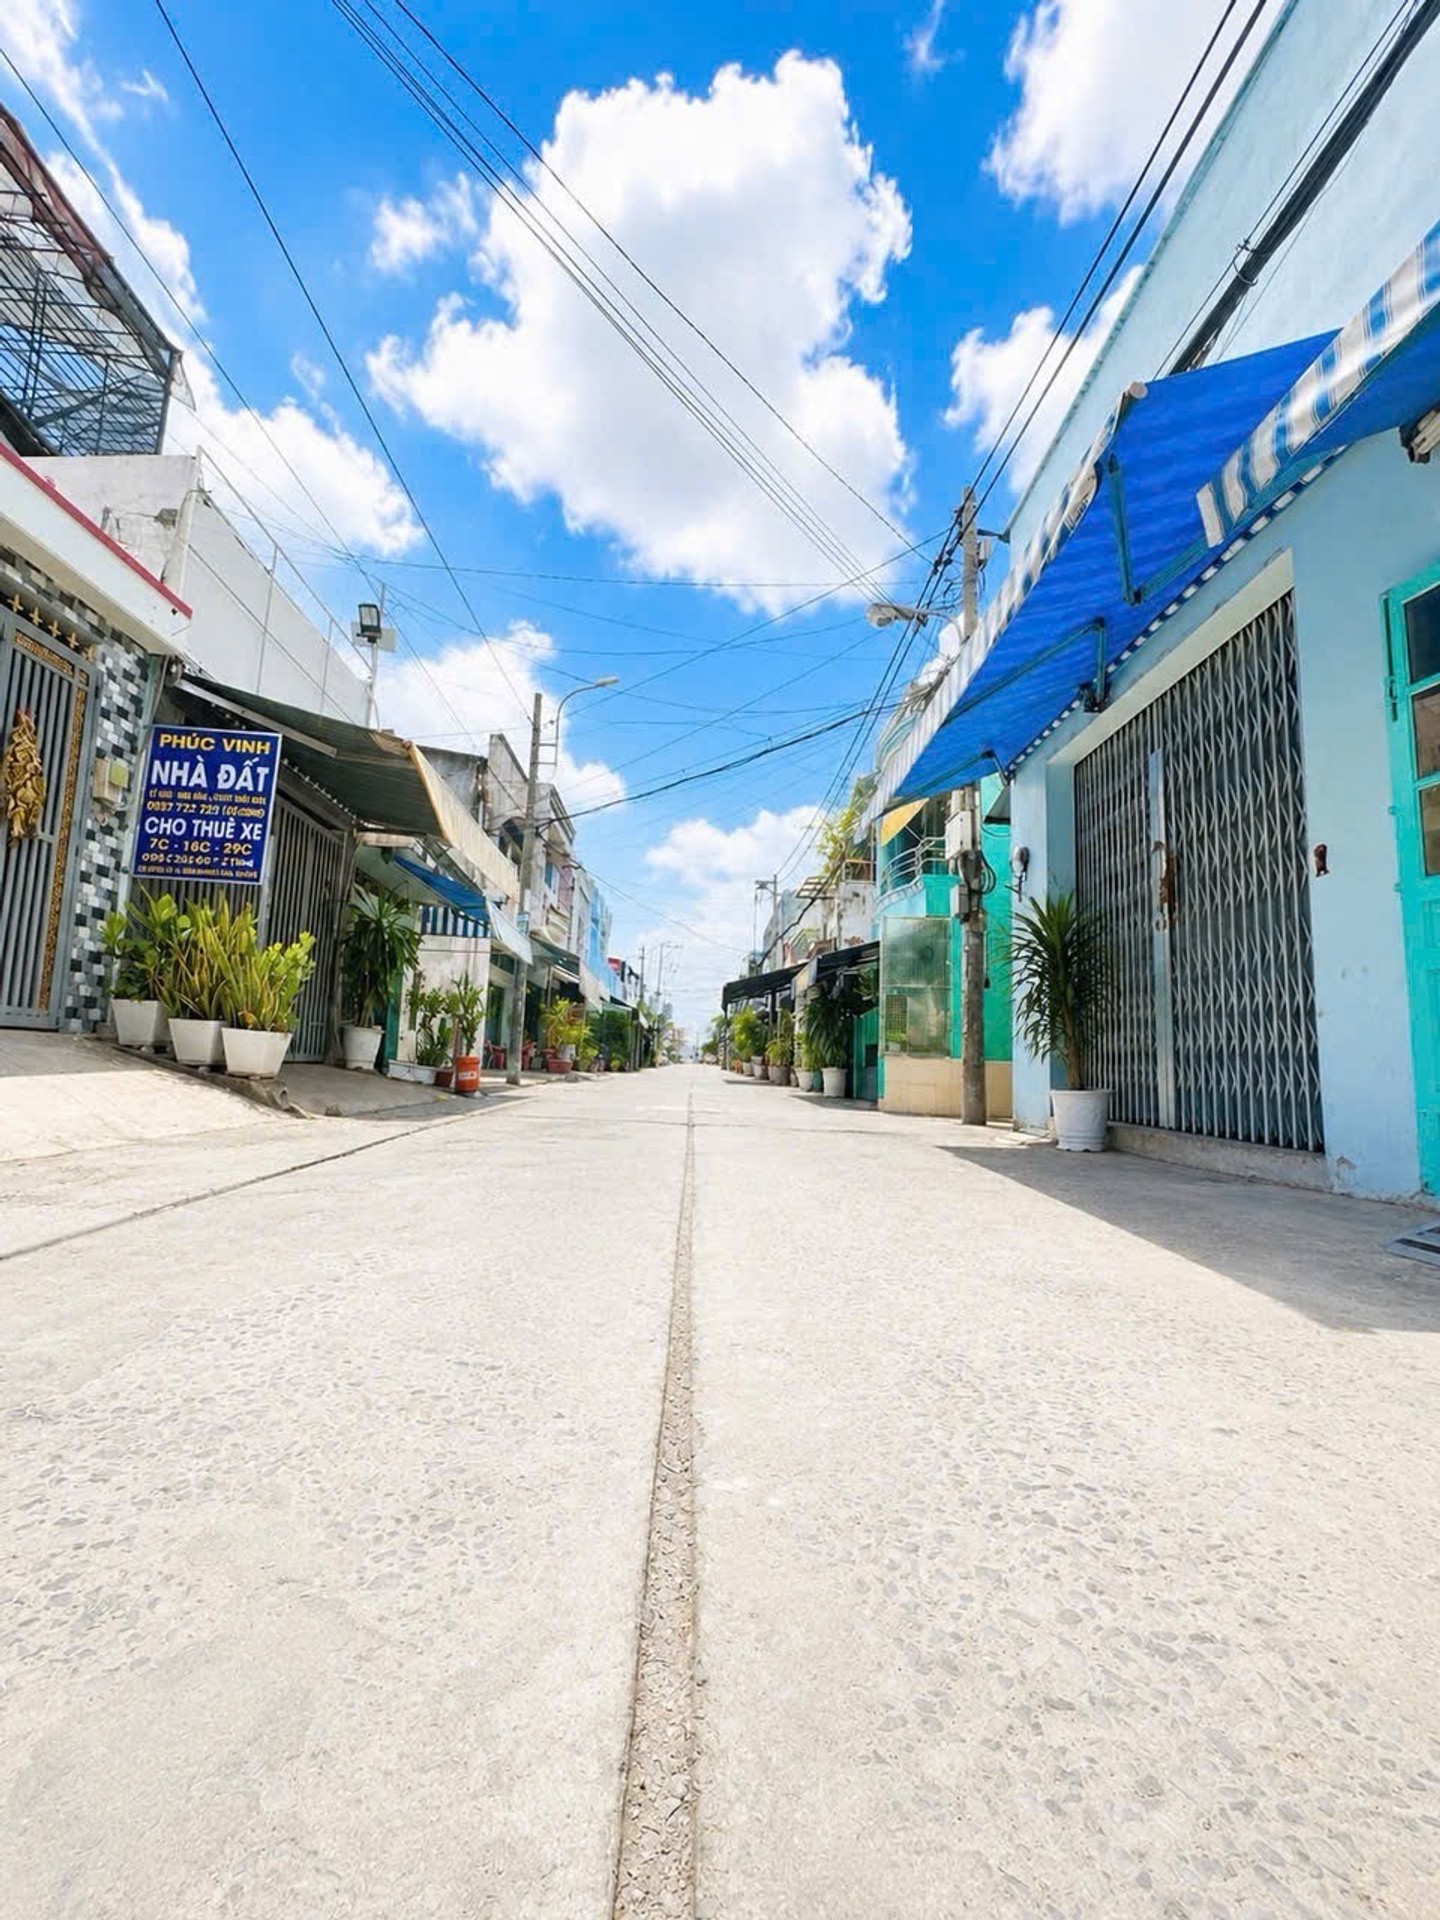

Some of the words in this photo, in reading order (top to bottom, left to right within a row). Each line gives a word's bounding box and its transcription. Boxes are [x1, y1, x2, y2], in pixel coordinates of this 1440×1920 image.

[159, 732, 215, 751] PHÚC
[222, 738, 271, 755] VINH
[150, 755, 208, 788] NHÀ
[216, 757, 270, 792] ĐẤT
[144, 817, 187, 836] CHO
[239, 823, 263, 841] XE
[149, 838, 170, 850] 7C
